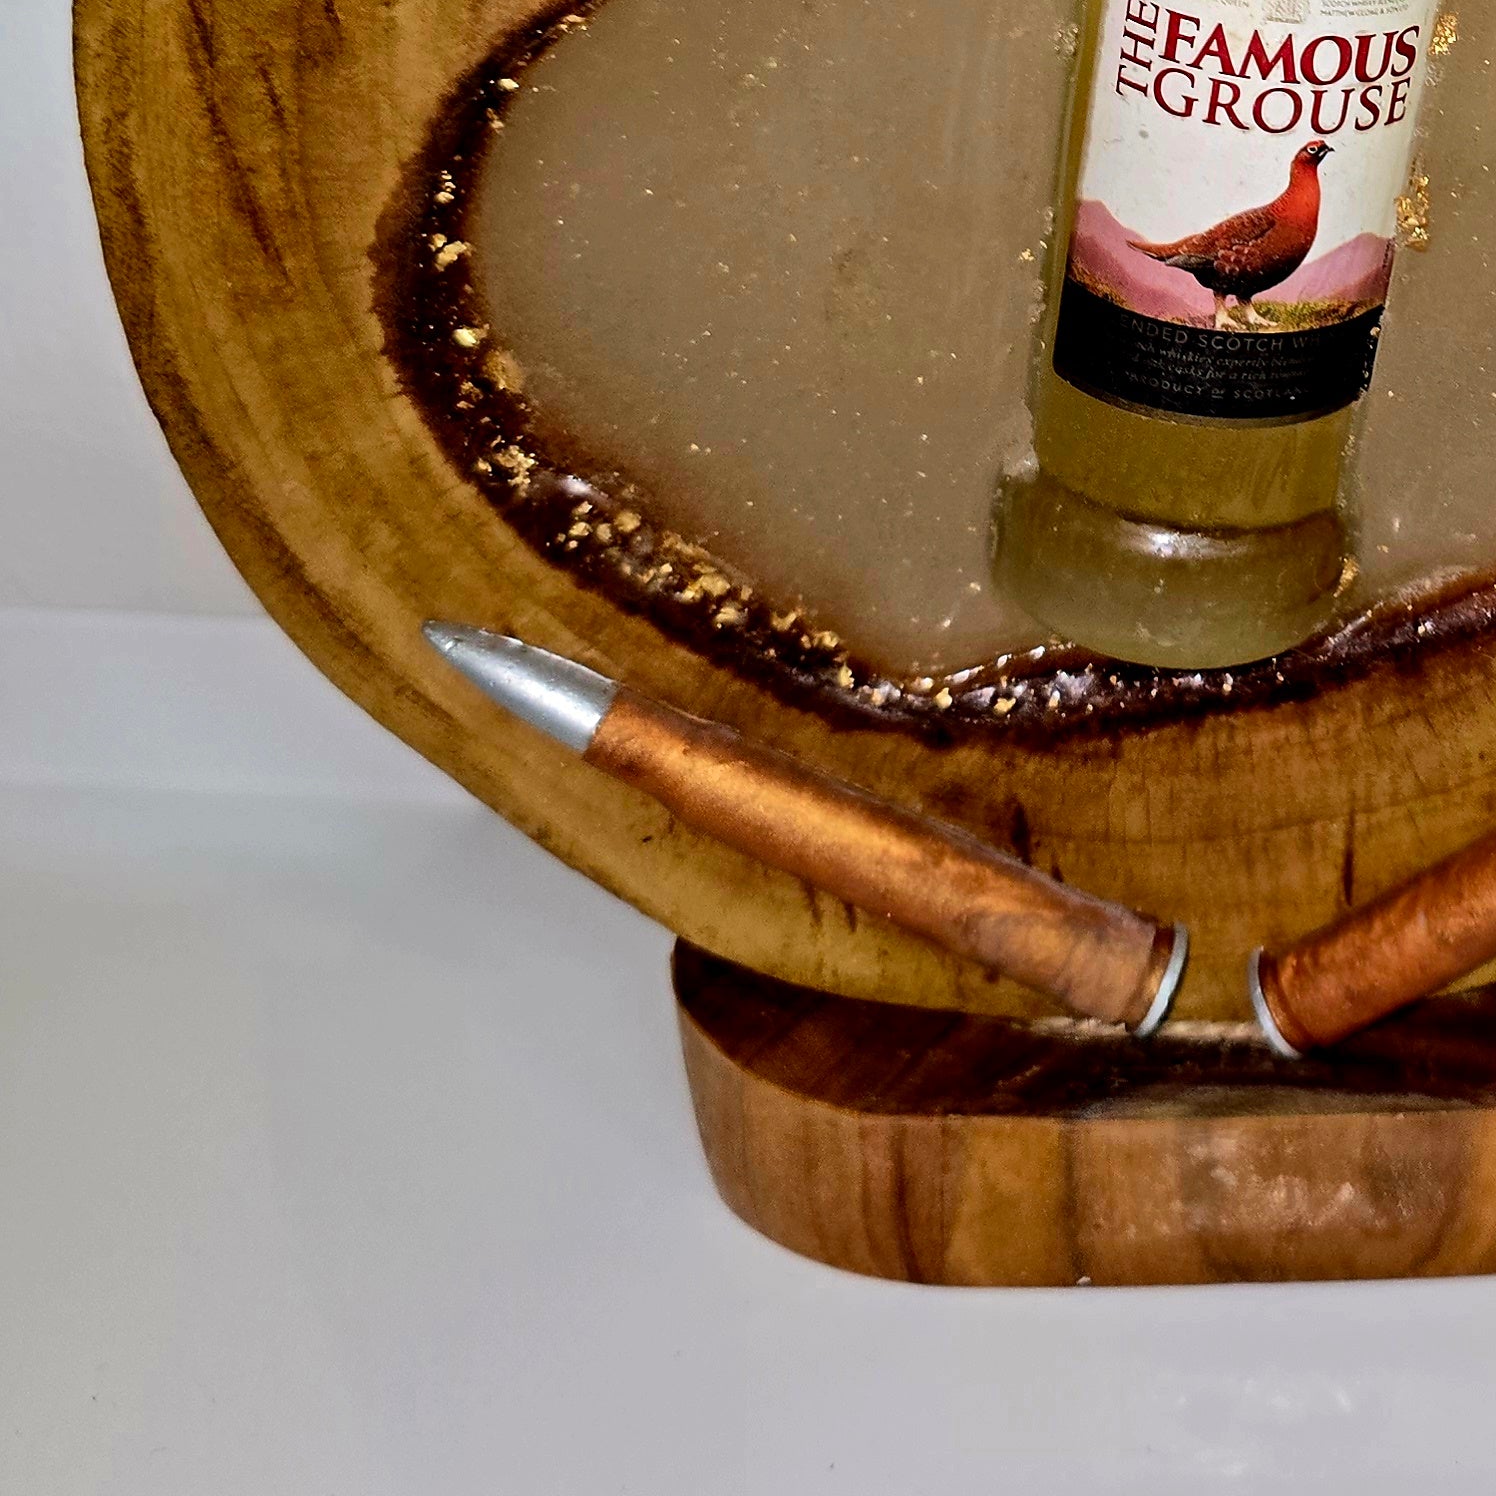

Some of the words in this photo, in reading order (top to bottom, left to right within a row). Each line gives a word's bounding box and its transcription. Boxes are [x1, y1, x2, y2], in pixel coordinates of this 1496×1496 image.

[1158, 8, 1420, 86] FAMOUS
[1152, 67, 1412, 135] GROUSE
[1120, 313, 1188, 344] ENDED
[1197, 333, 1284, 352] SCOTCH
